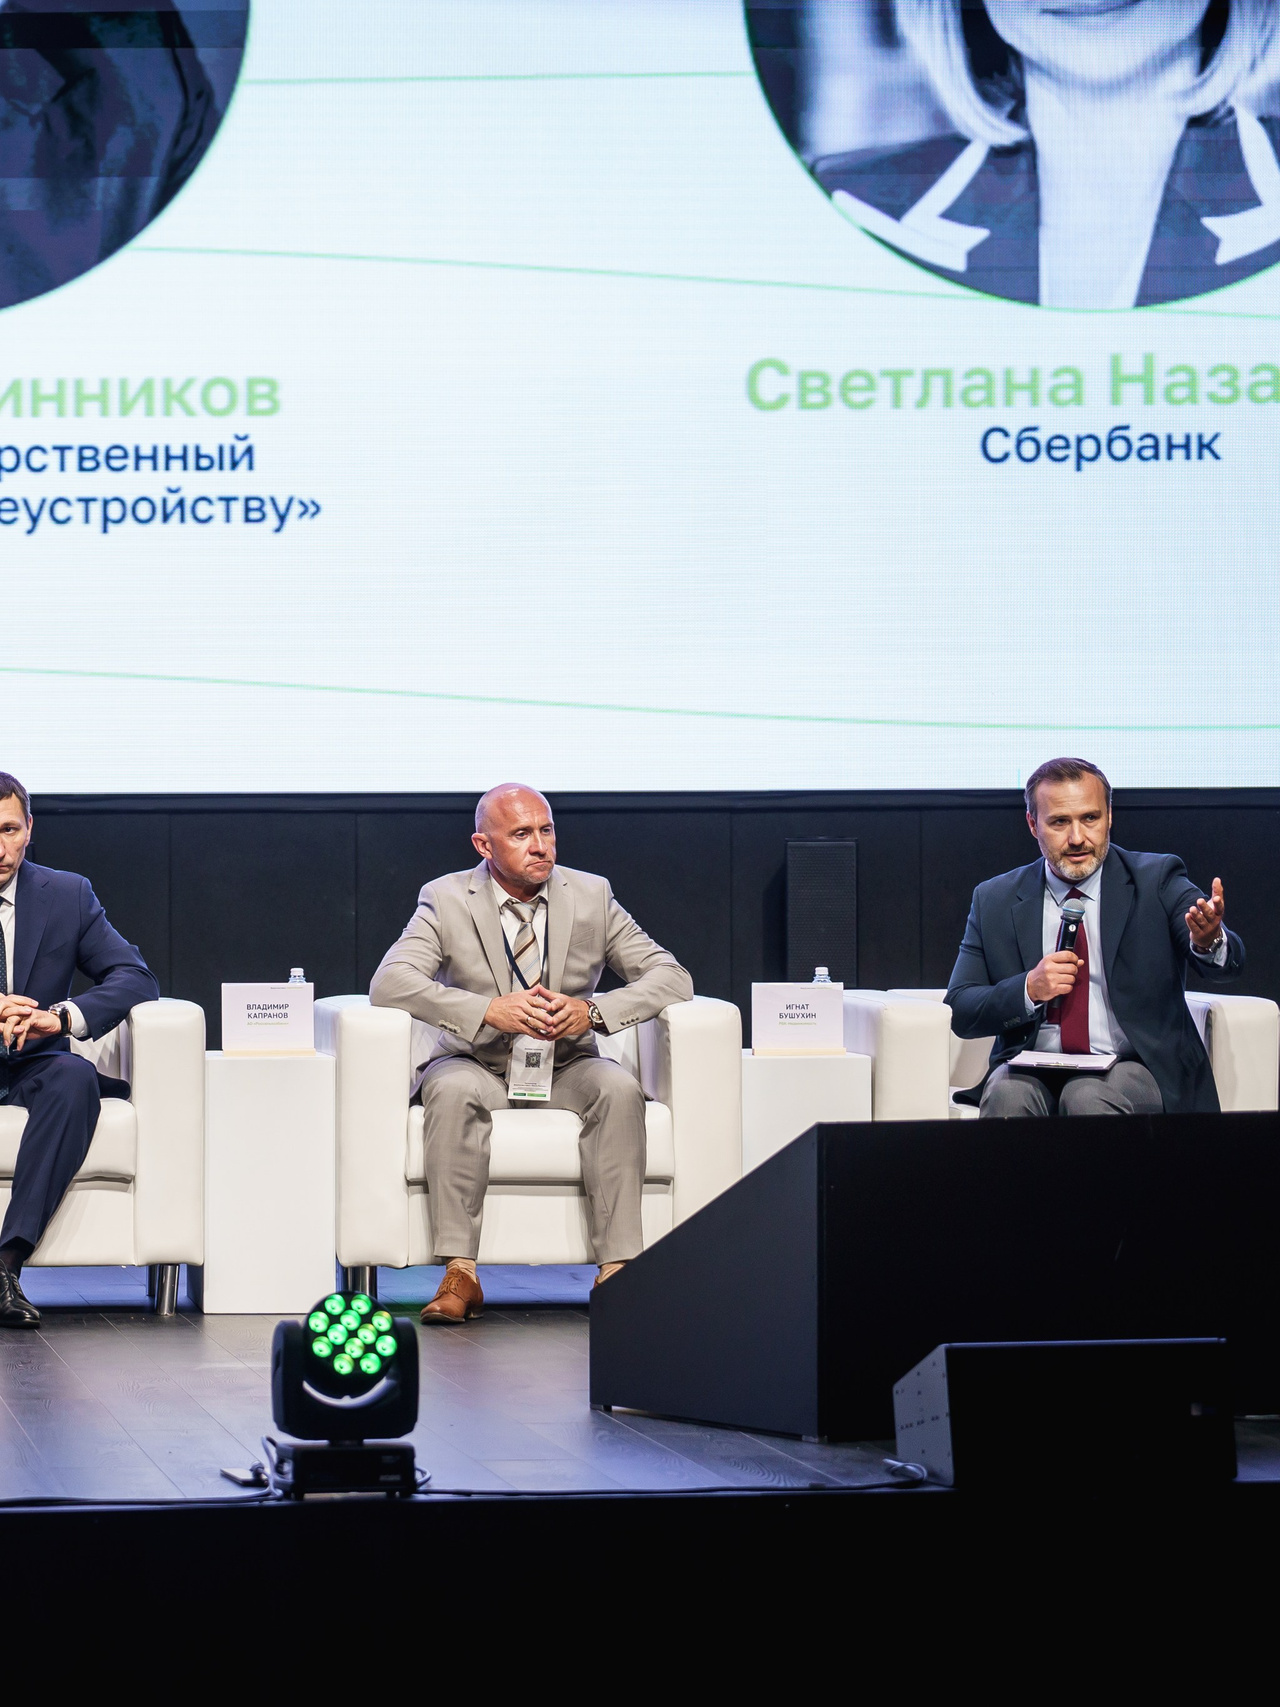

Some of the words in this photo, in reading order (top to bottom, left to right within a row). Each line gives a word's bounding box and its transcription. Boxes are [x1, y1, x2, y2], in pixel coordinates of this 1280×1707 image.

[746, 357, 1086, 412] Светлана
[1110, 353, 1280, 406] Наза
[980, 425, 1222, 473] Сбербанк
[246, 1003, 290, 1011] ВЛАДИМИР
